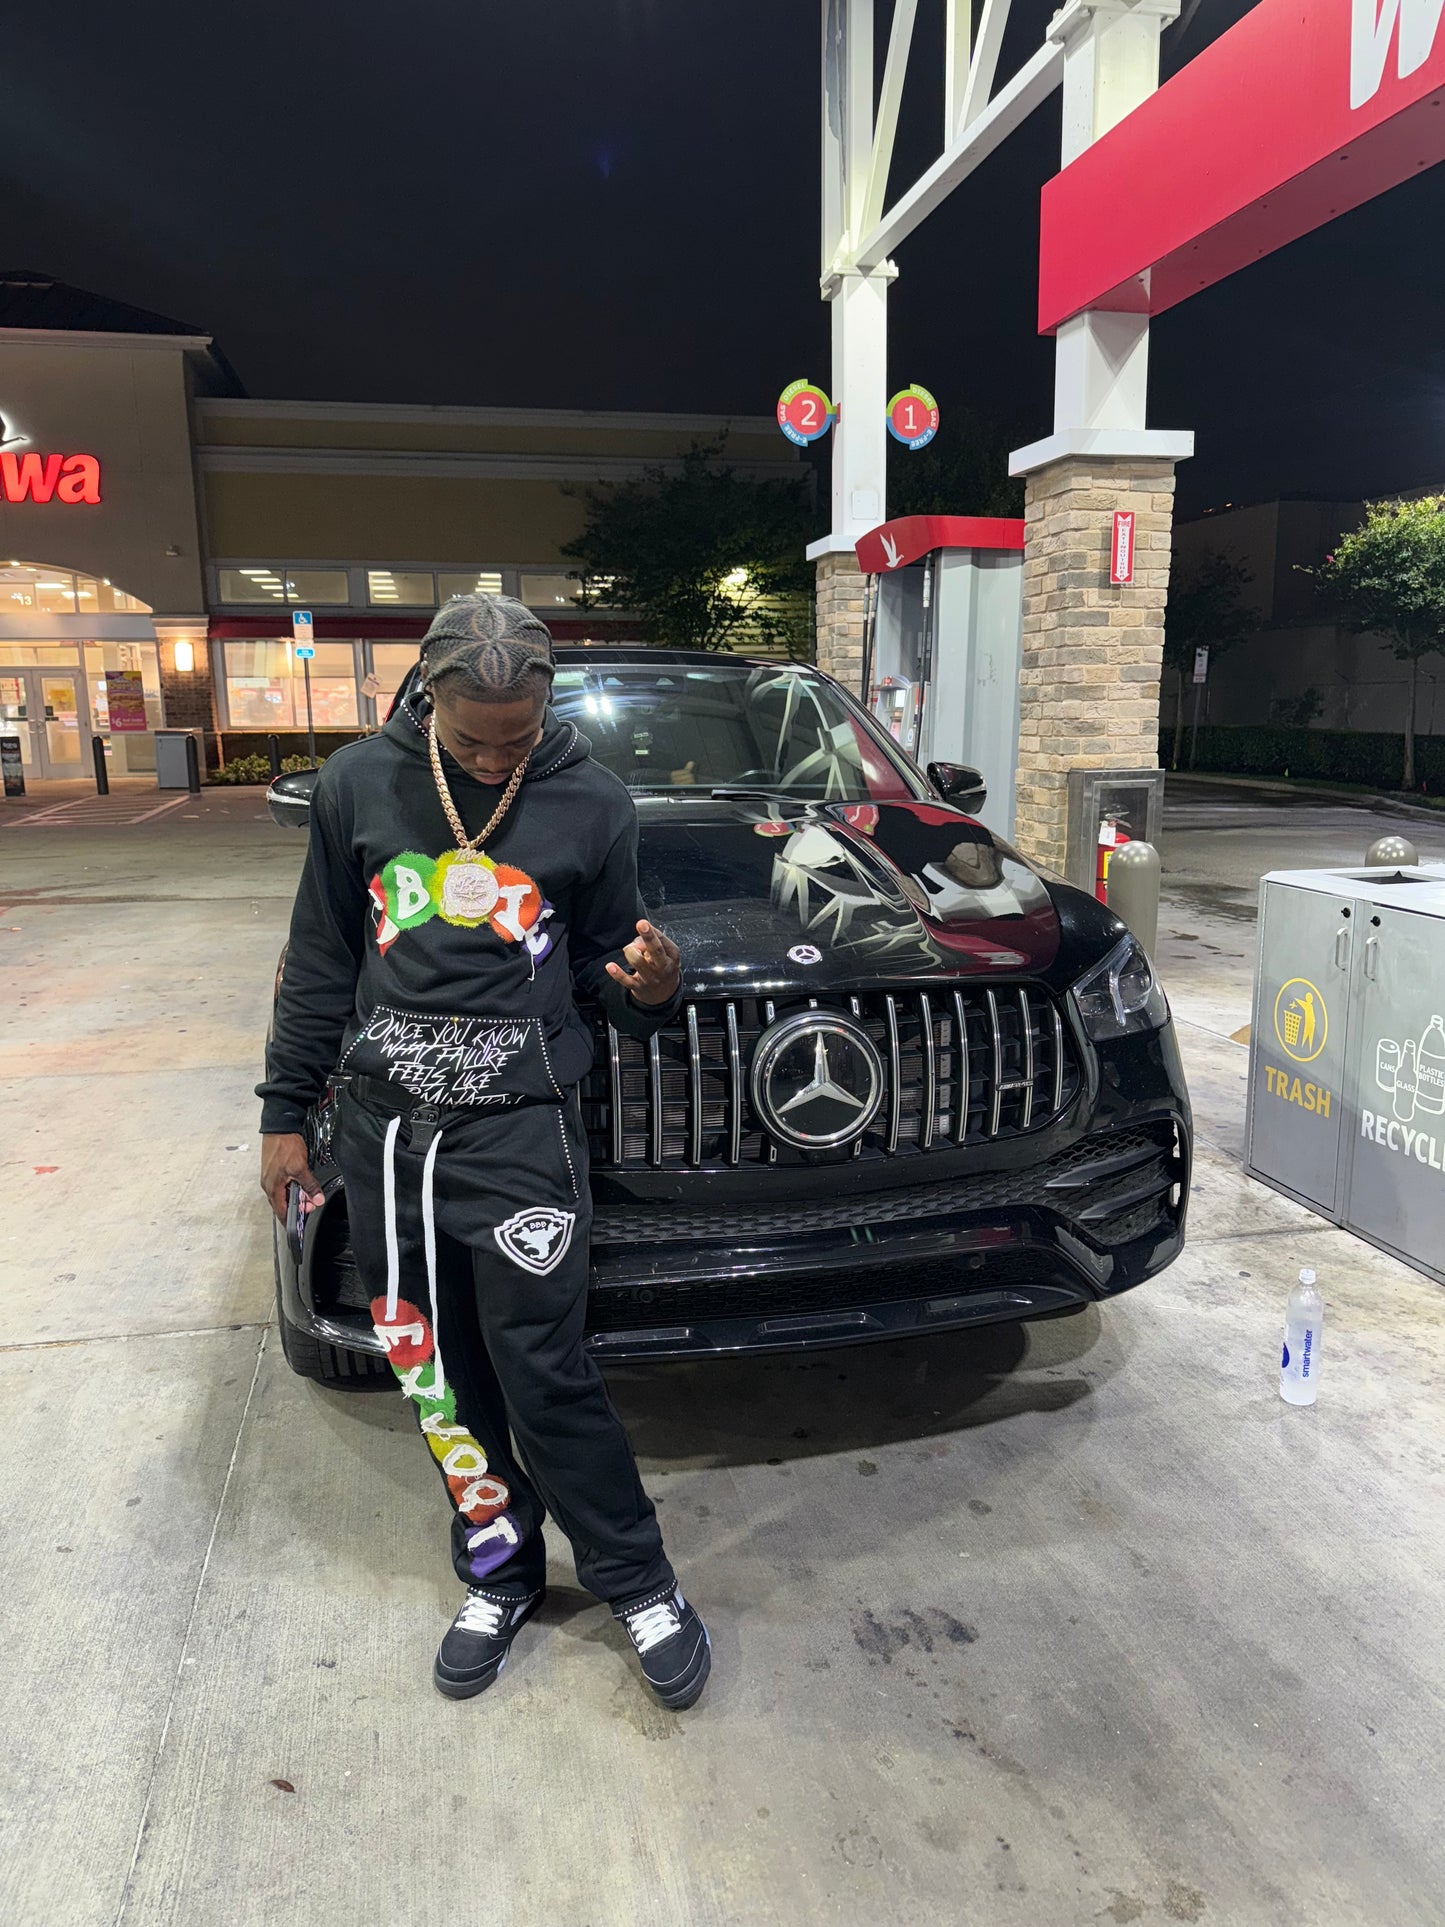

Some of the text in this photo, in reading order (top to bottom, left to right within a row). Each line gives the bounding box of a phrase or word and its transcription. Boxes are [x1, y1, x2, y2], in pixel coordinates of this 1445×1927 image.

[783, 382, 806, 401] DIESEL
[912, 387, 934, 407] DIESEL
[801, 400, 817, 426] 2
[904, 405, 917, 430] 1
[0, 452, 101, 504] wa
[367, 1014, 531, 1048] ONCE YOU KNOW
[380, 1038, 519, 1073] WHAT FAILURE
[1380, 1061, 1396, 1073] CANS
[388, 1061, 502, 1093] FEELS LIKE
[1418, 1071, 1445, 1088] BOTTLES
[1419, 1064, 1445, 1080] PLASTIC
[1264, 1065, 1331, 1118] TRASH
[1396, 1079, 1416, 1093] GLASS
[1361, 1109, 1445, 1173] RECYCL
[1302, 1329, 1313, 1378] smartwater
